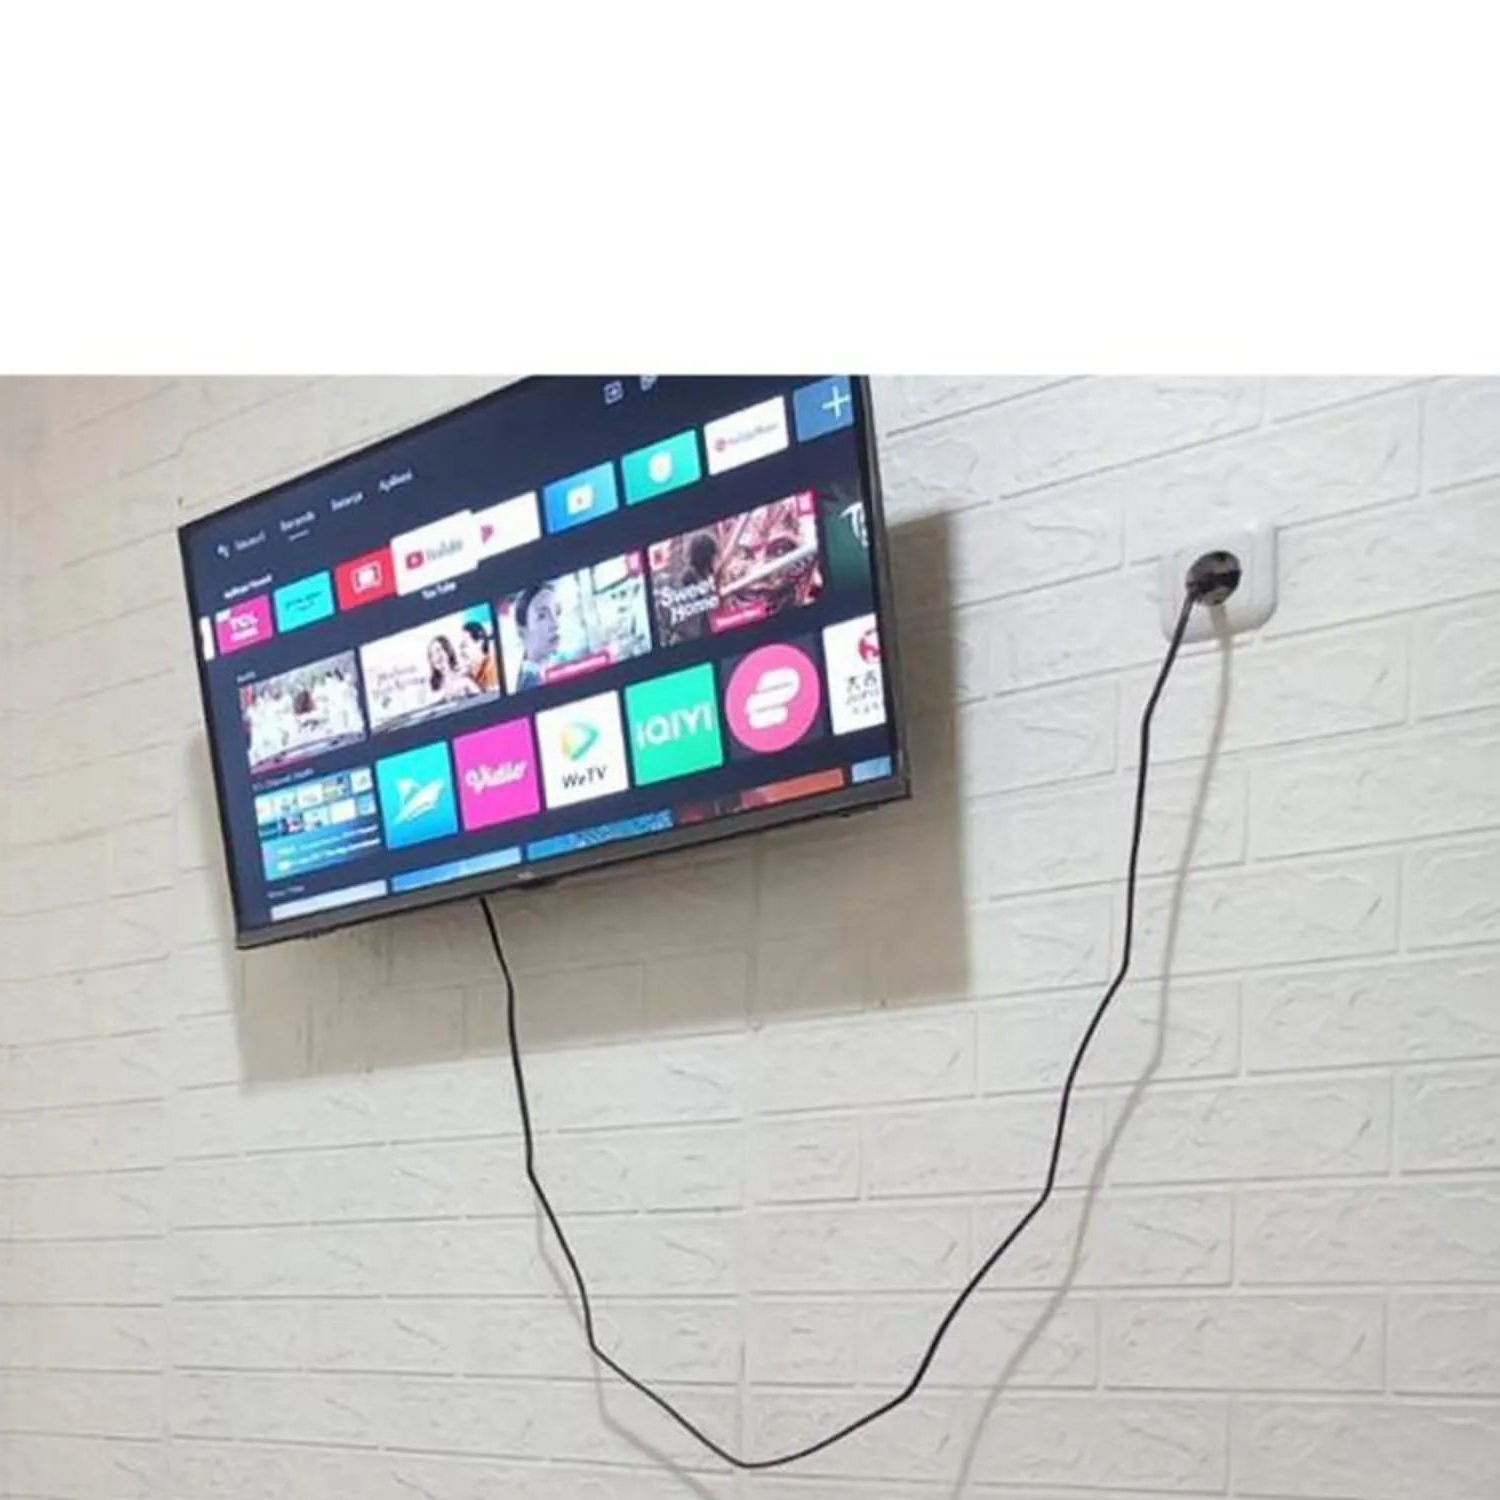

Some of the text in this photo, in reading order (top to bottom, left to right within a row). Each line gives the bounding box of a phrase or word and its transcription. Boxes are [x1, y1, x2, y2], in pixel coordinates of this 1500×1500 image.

[654, 576, 716, 607] Sweet
[670, 594, 720, 624] Home
[560, 765, 609, 790] WeTV
